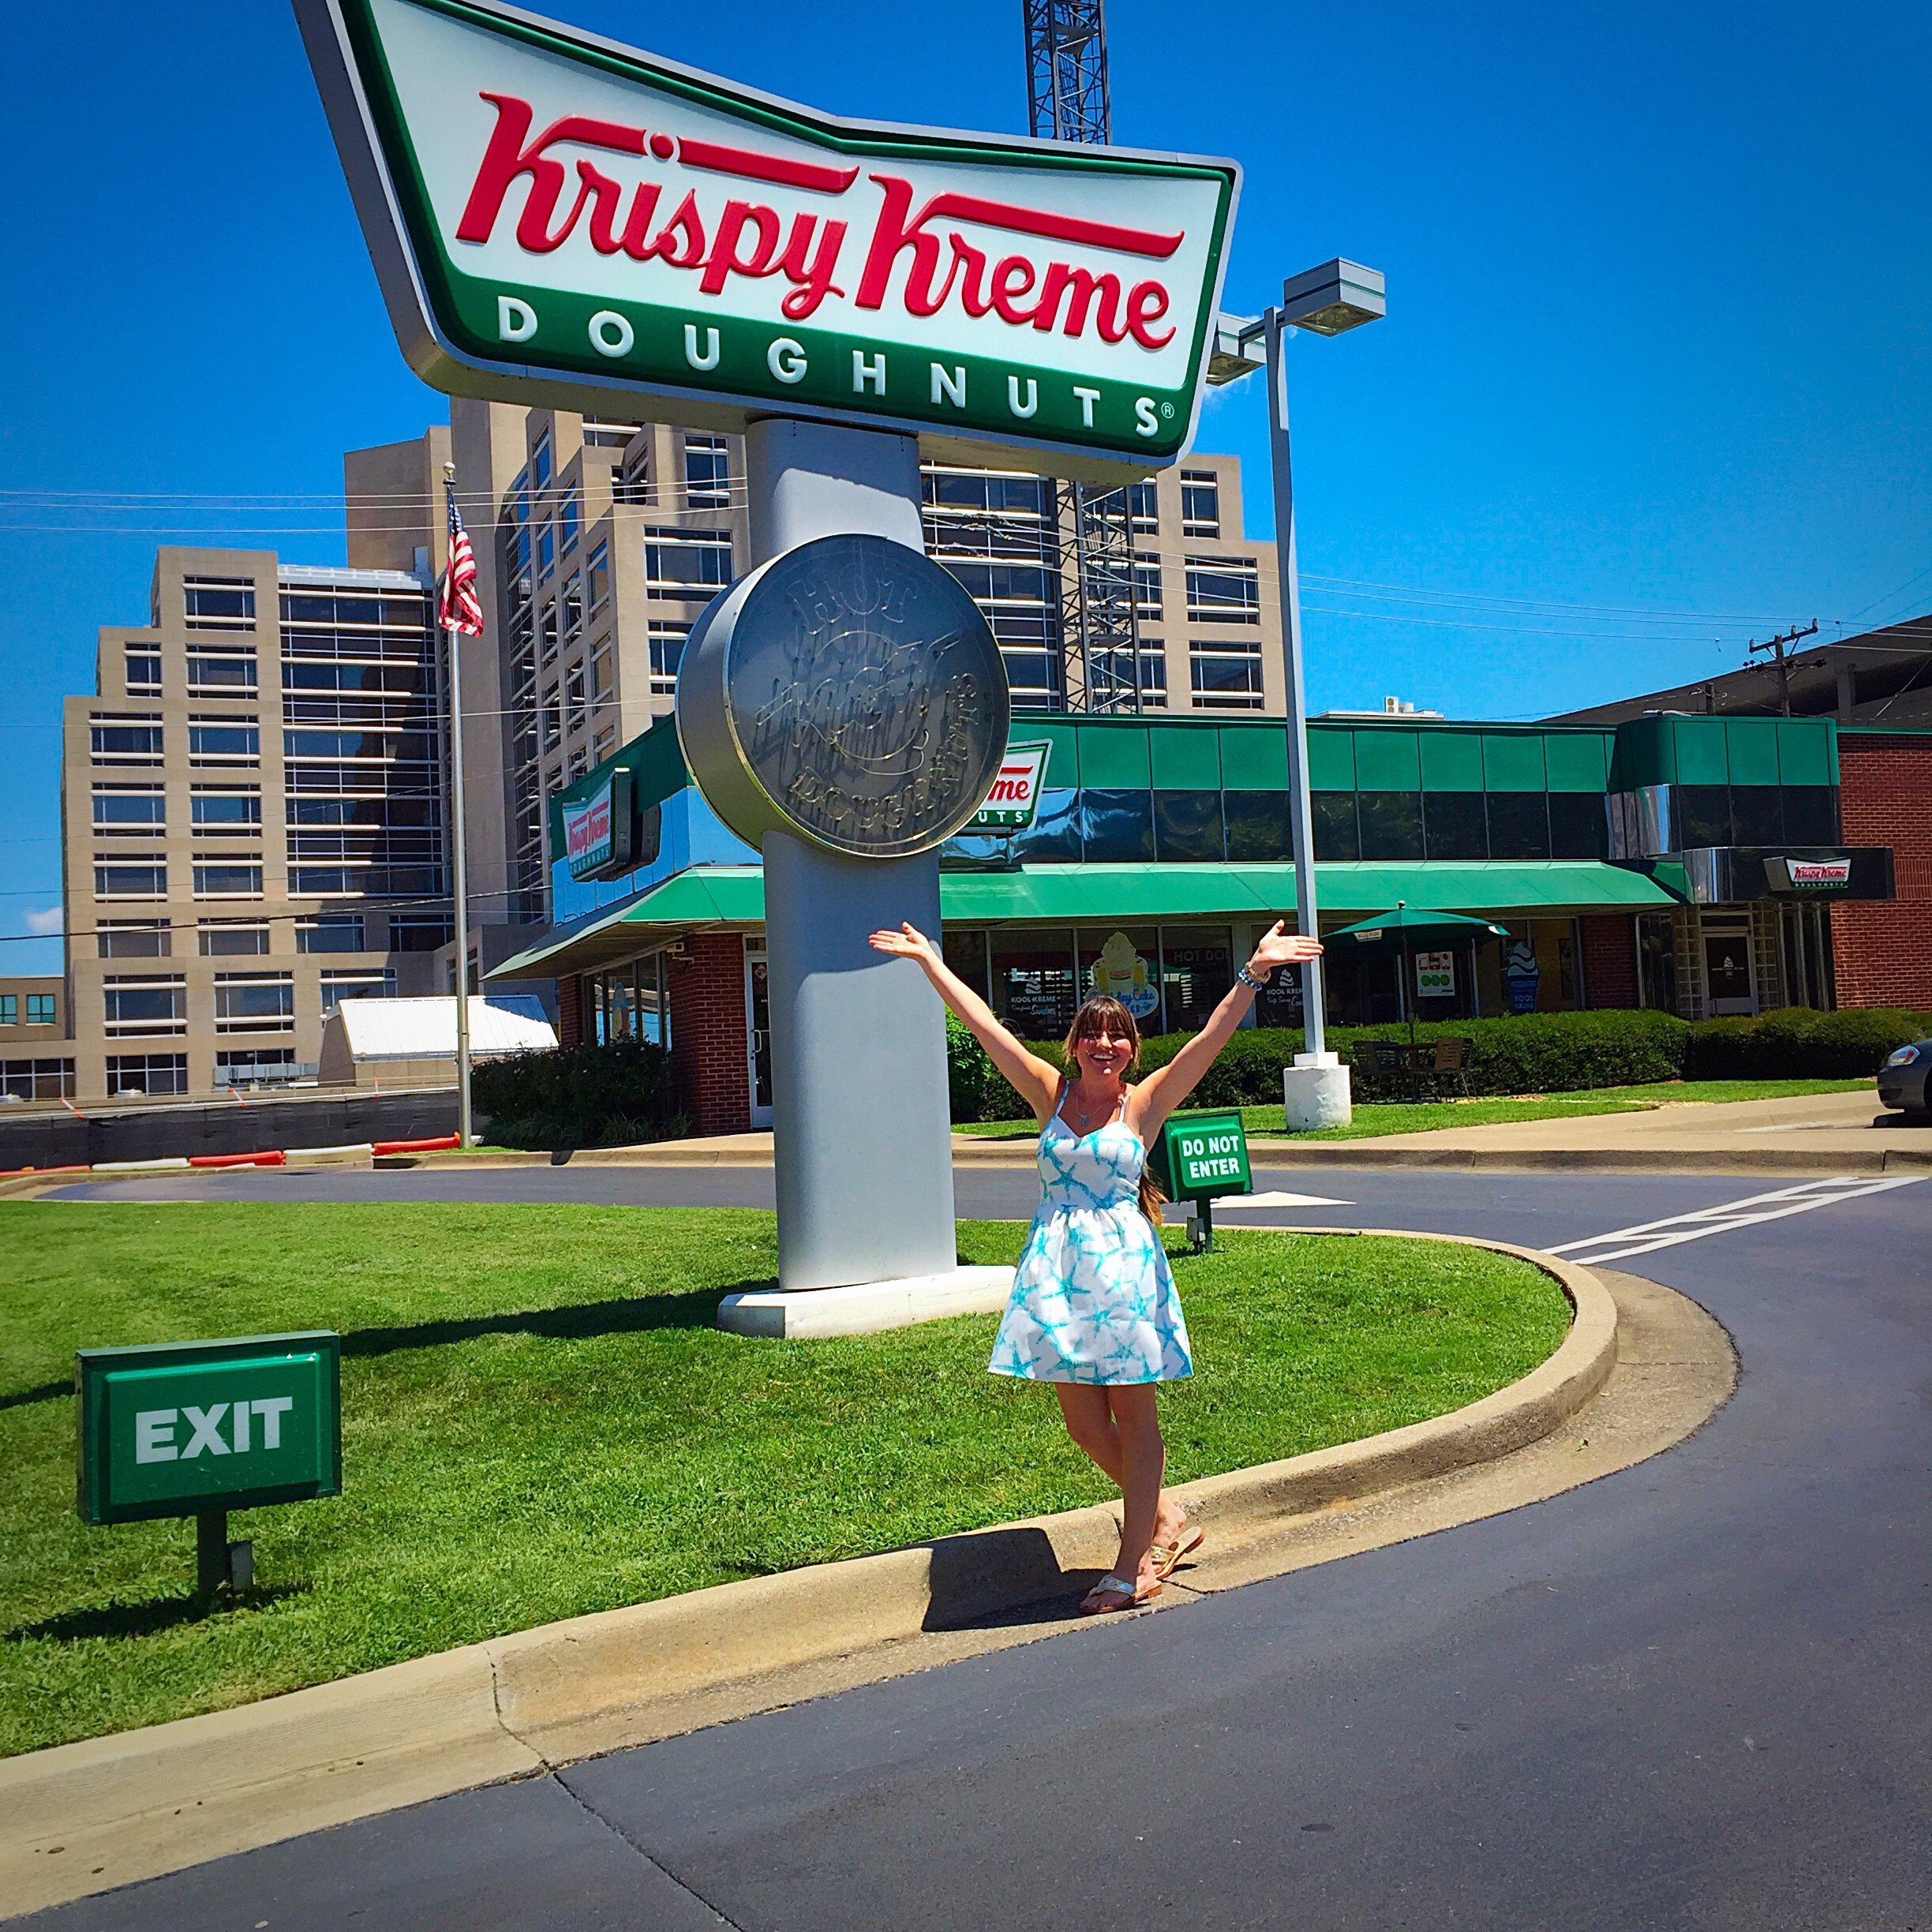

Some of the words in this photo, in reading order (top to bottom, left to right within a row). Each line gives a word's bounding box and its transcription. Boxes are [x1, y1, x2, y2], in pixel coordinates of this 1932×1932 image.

[457, 92, 859, 320] Krispy
[855, 175, 1184, 349] Kreme
[1174, 950, 1200, 961] HOT
[1182, 1139, 1204, 1157] DO
[1209, 1136, 1239, 1154] NOT
[1189, 1157, 1240, 1178] ENTER
[135, 1396, 293, 1465] EXIT
